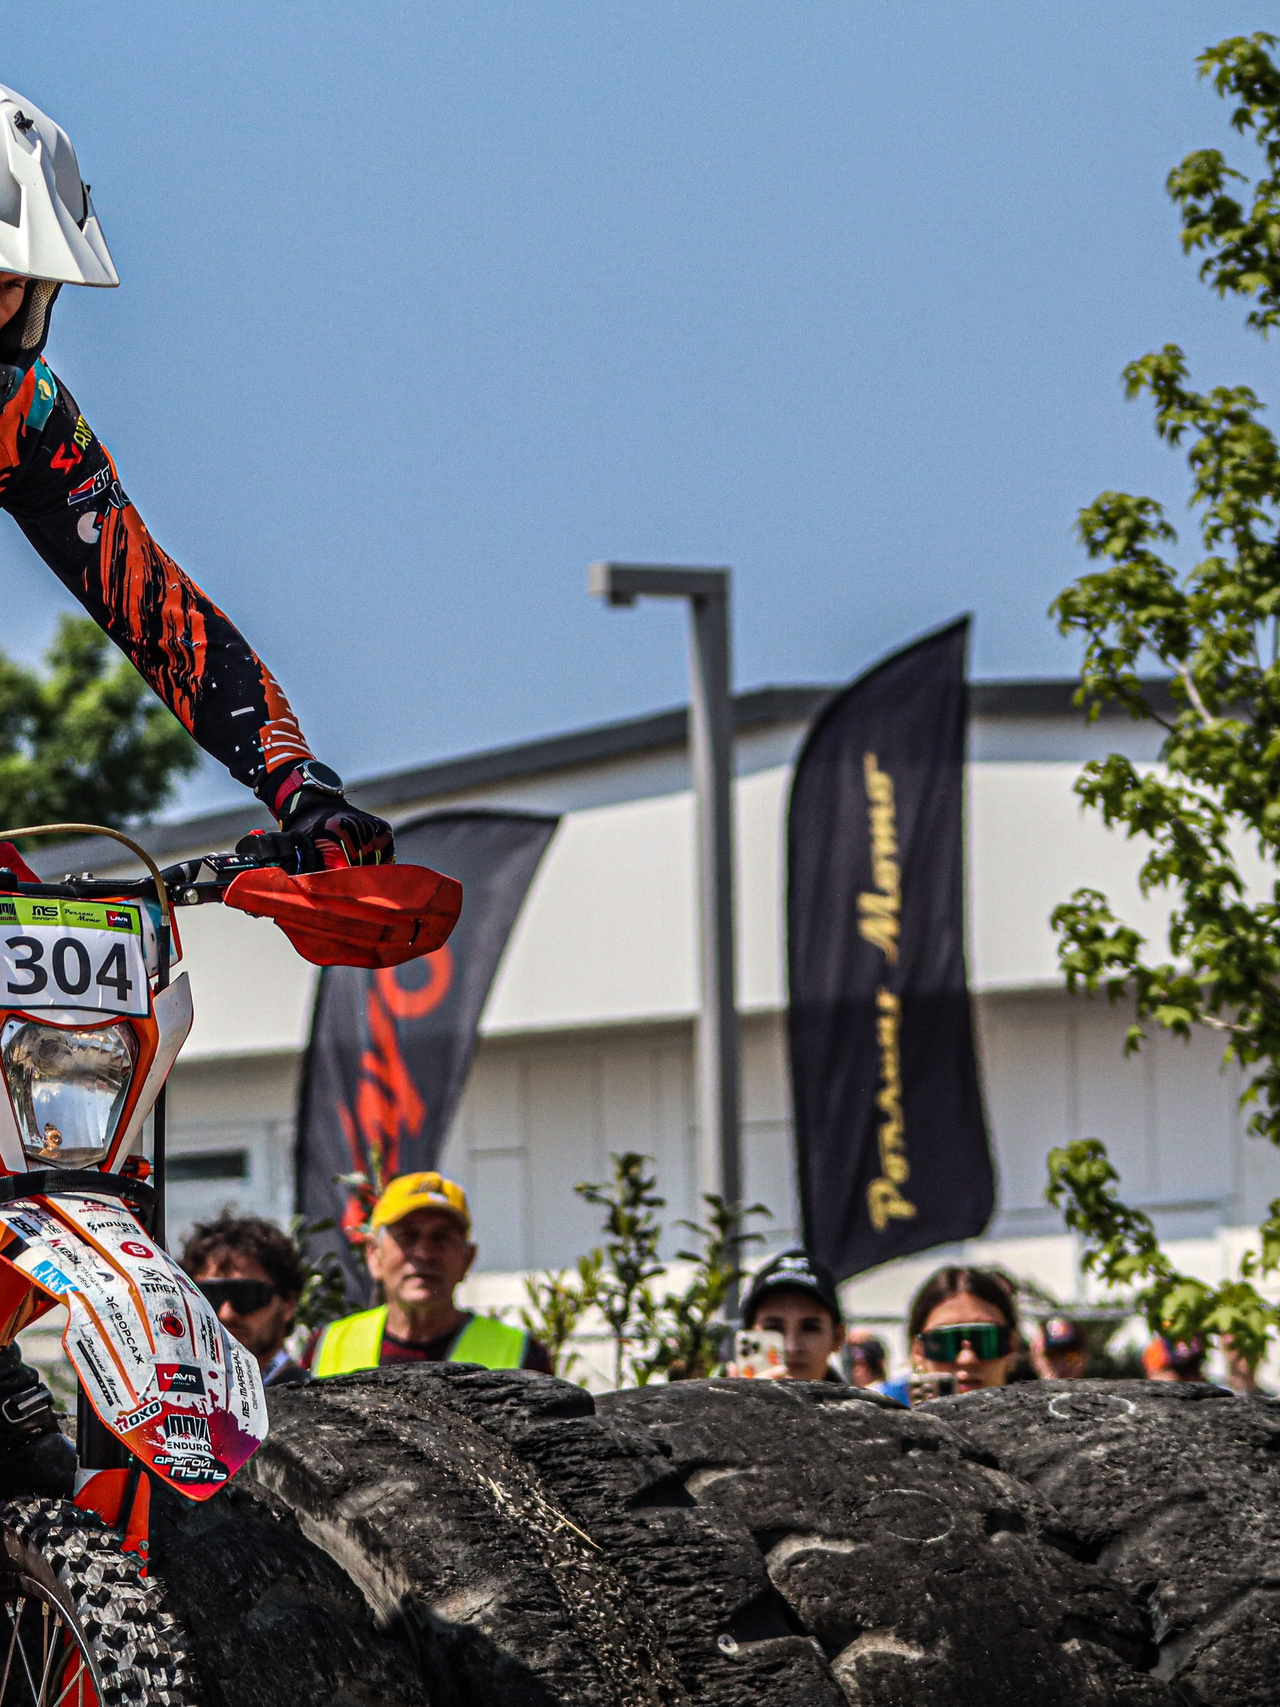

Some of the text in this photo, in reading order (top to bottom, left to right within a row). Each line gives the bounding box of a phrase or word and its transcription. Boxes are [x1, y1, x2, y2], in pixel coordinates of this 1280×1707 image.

[5, 935, 133, 1002] 304
[140, 1282, 179, 1294] TIREX
[115, 1312, 145, 1365] ФОРСАЖ
[163, 1372, 197, 1383] LAVR
[113, 1401, 161, 1433] ROKO
[166, 1441, 211, 1452] ENDURO
[154, 1456, 211, 1468] ДРУГОЙ
[171, 1466, 228, 1481] ПУТЬ
